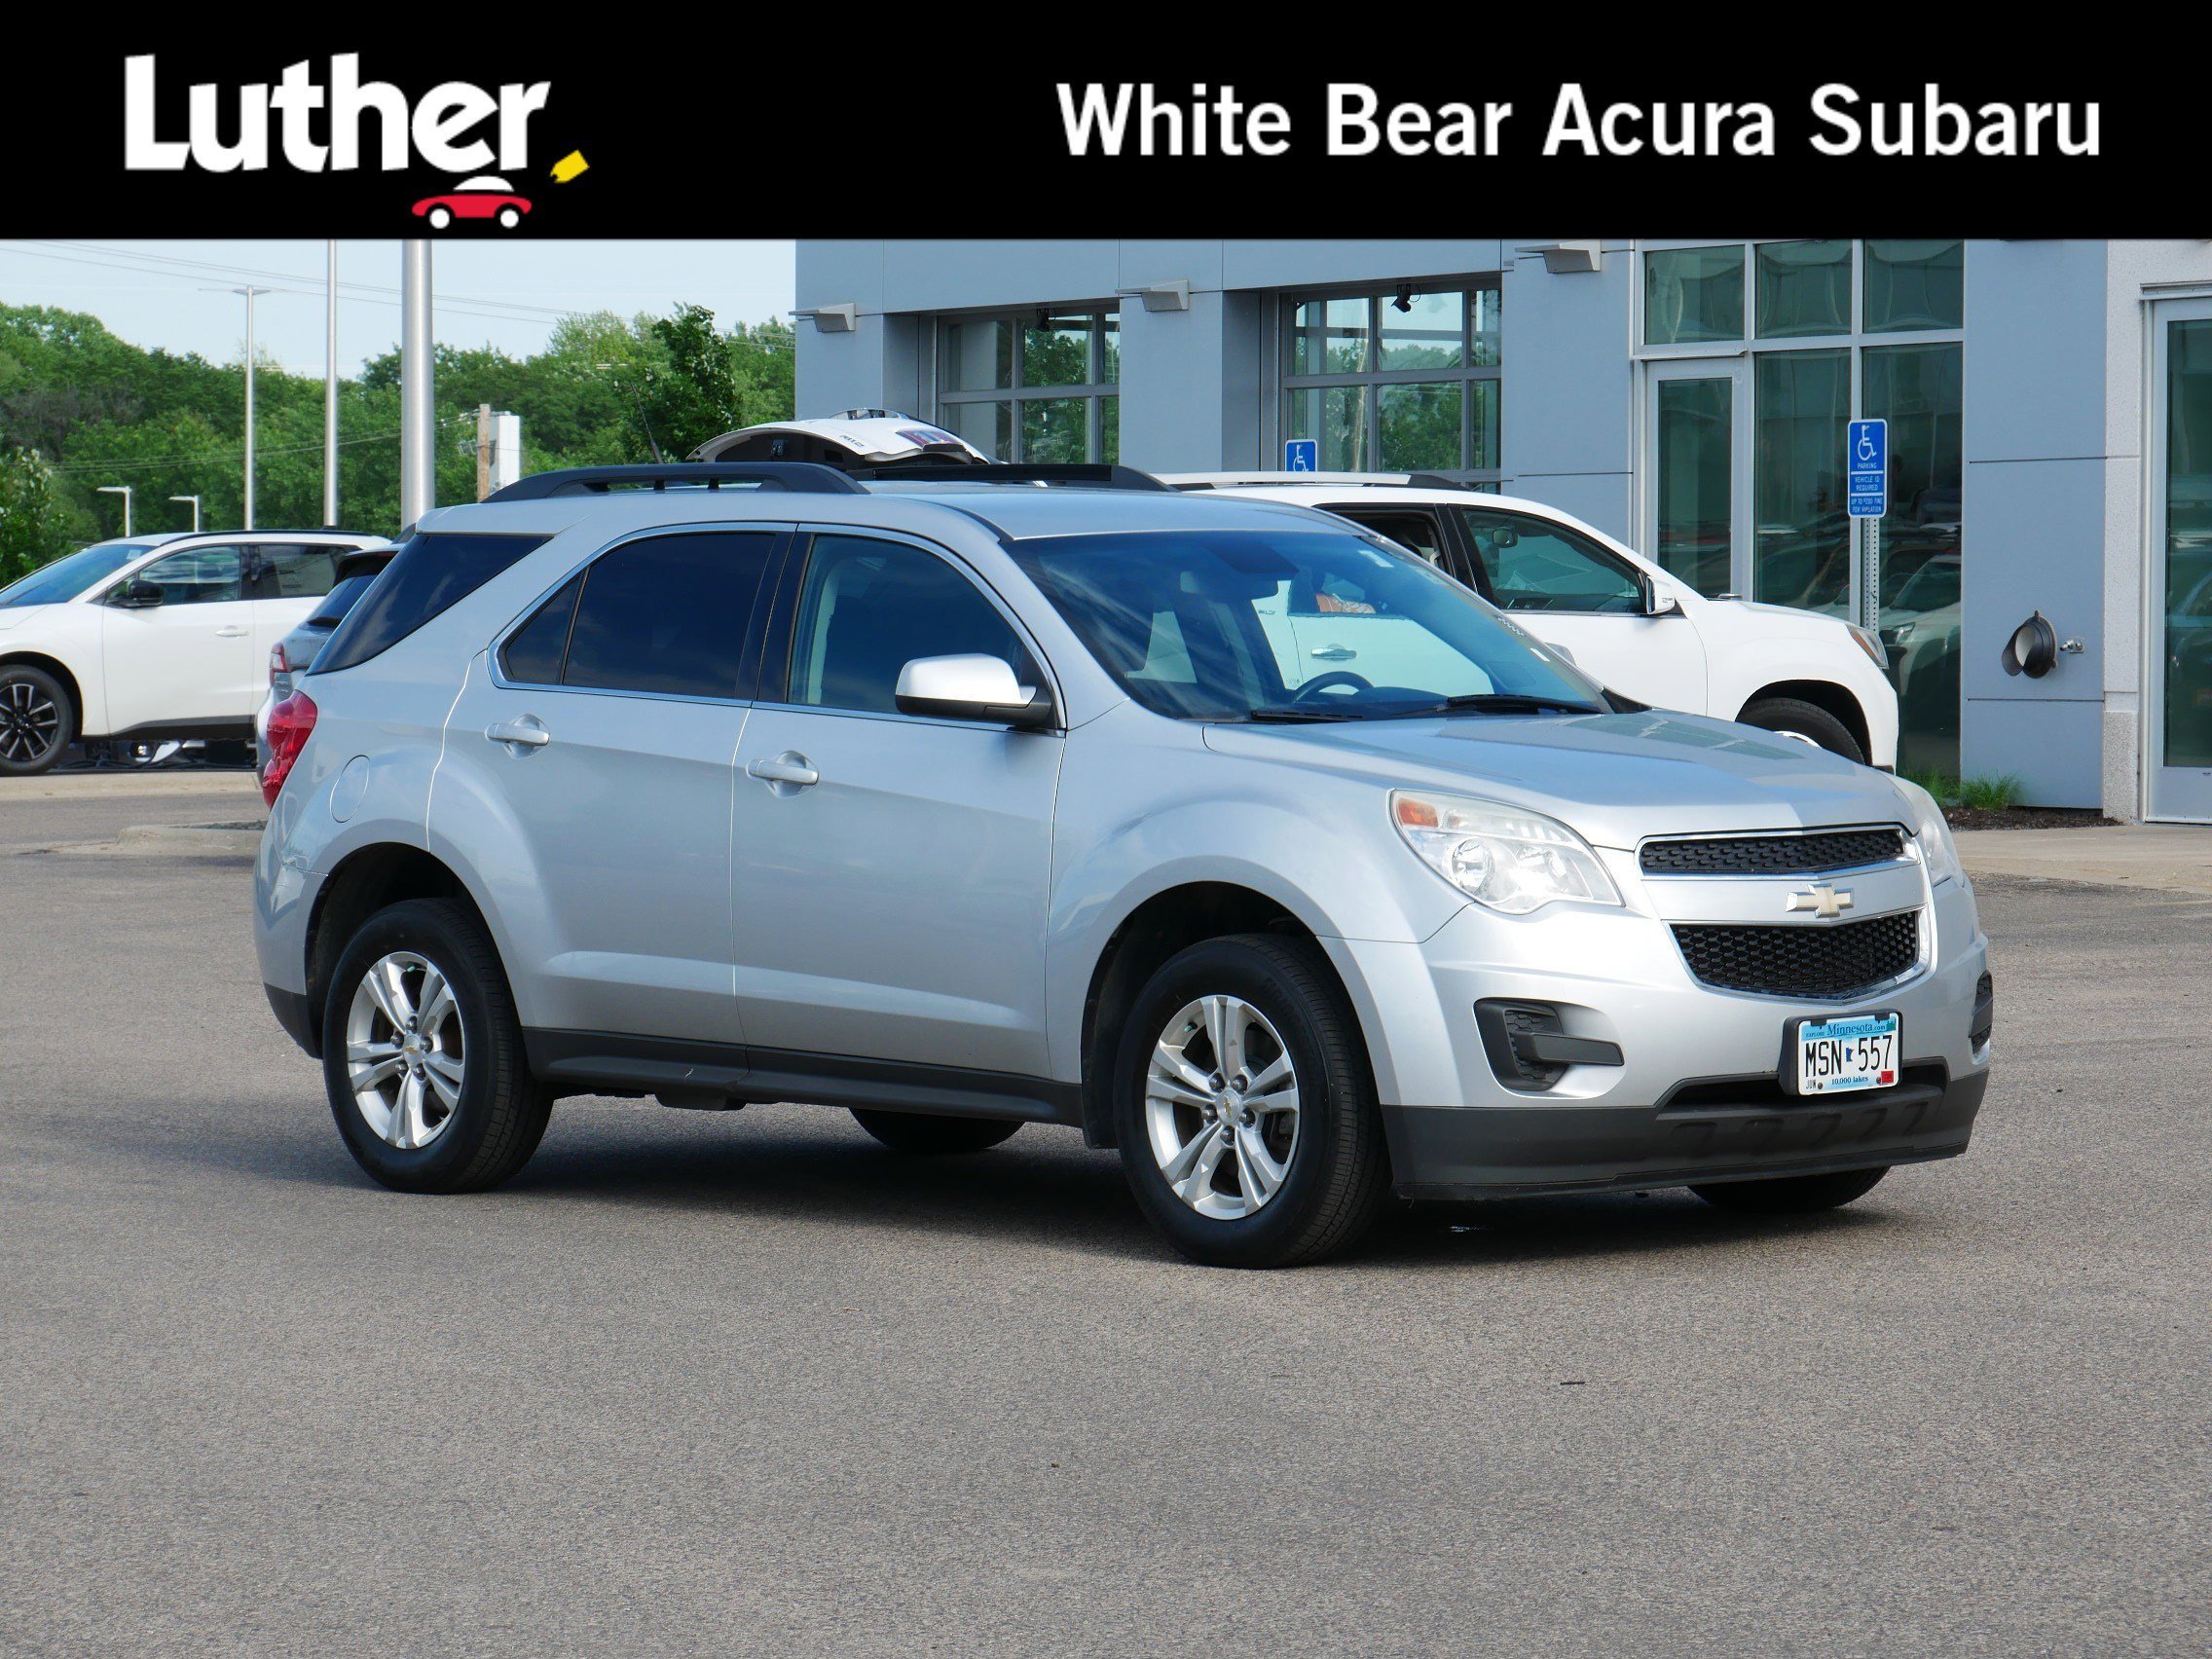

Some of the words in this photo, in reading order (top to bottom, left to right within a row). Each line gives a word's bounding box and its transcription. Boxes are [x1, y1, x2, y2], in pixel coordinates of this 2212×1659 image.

[1805, 1039, 1842, 1078] MSN
[1858, 1035, 1893, 1072] 557
[1831, 1076, 1852, 1086] 10,000
